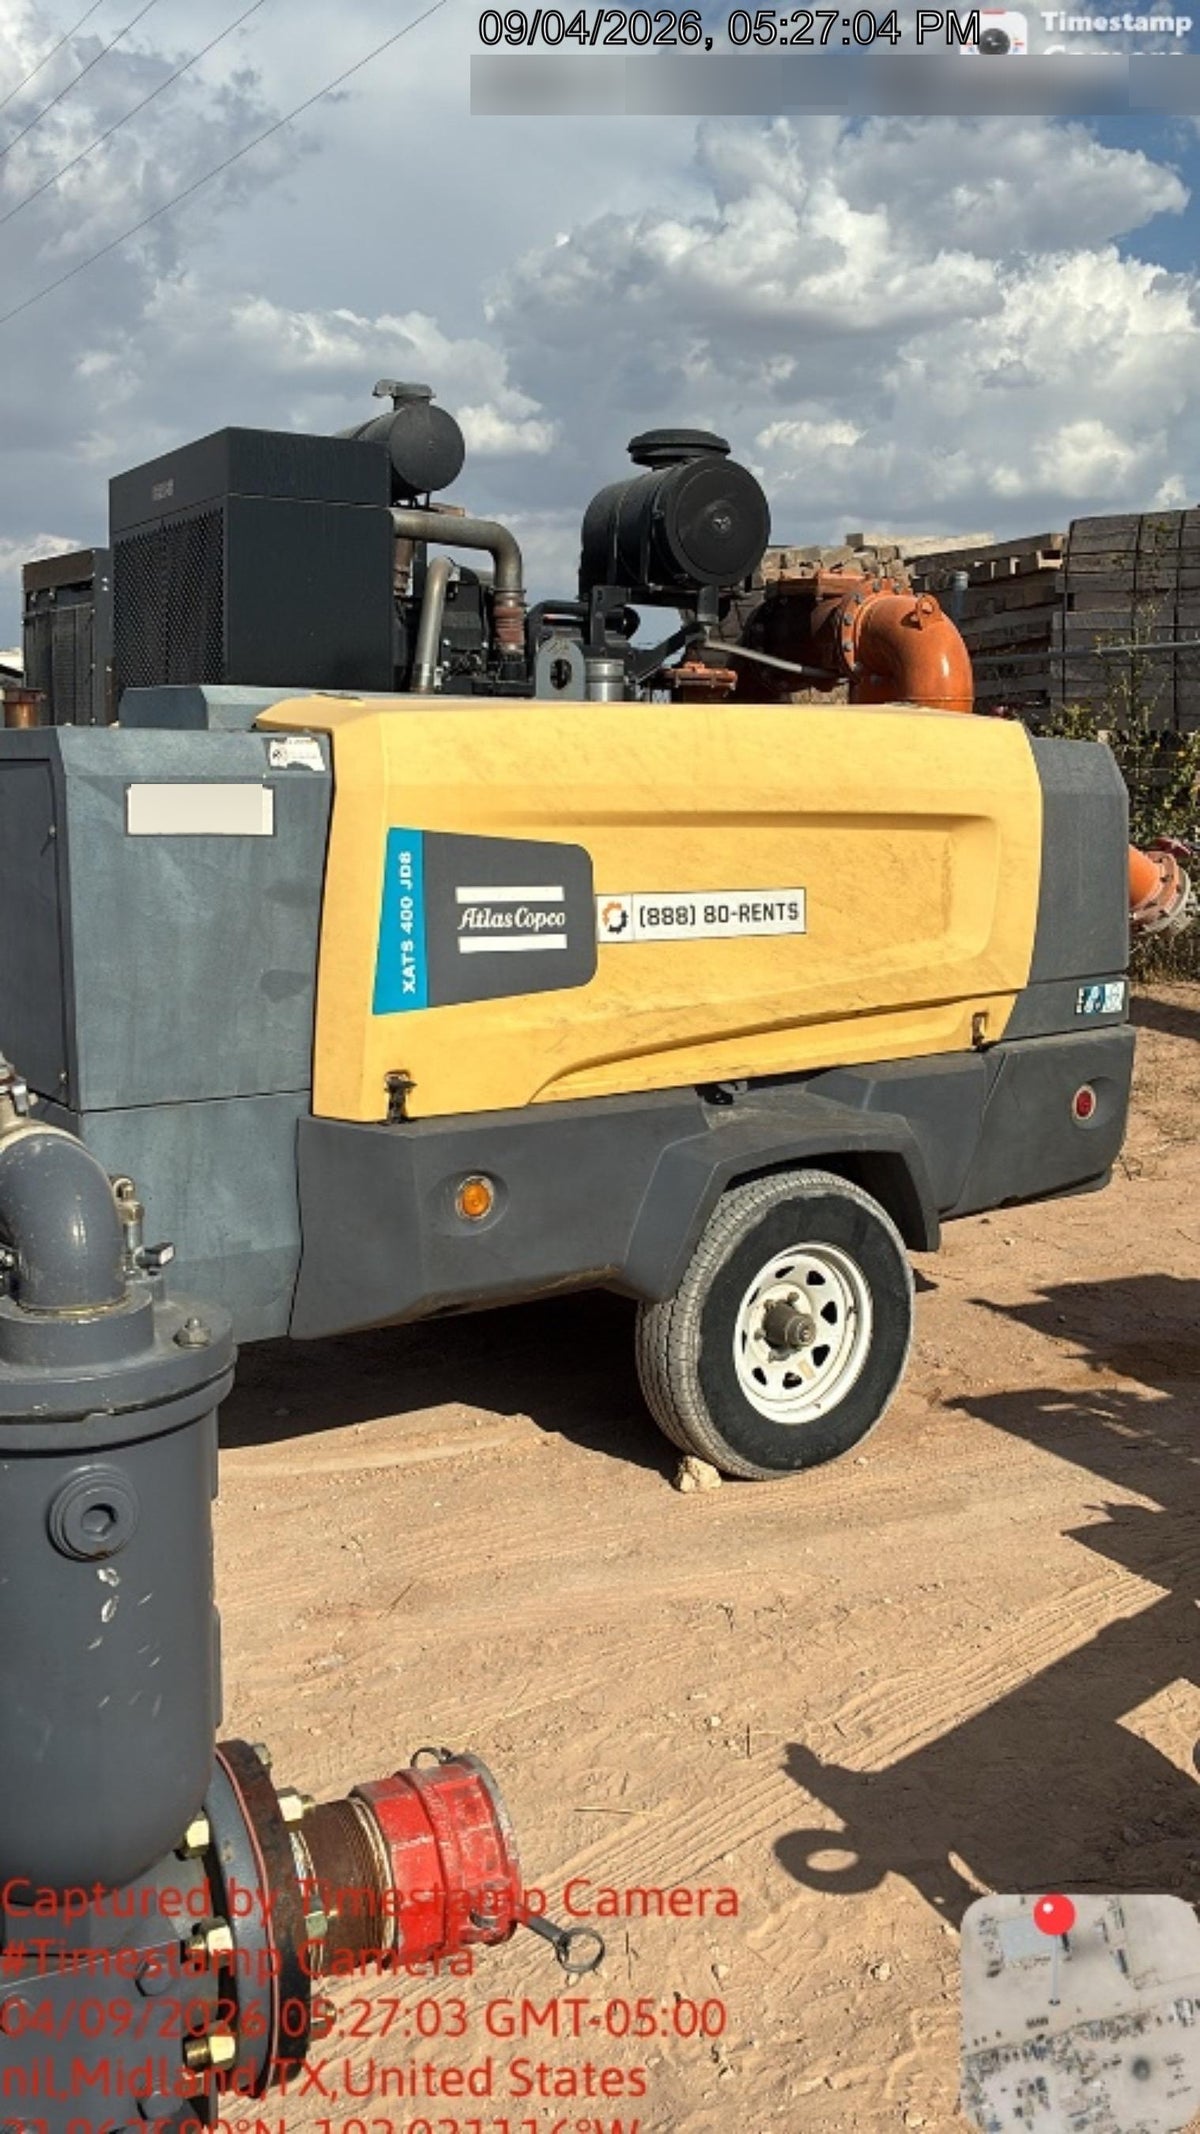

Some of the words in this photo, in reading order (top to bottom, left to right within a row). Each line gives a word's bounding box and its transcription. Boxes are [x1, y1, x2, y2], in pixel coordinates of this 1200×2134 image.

[400, 895, 414, 935] 400
[703, 902, 799, 924] 80-RENTS
[402, 939, 416, 995] XATS
